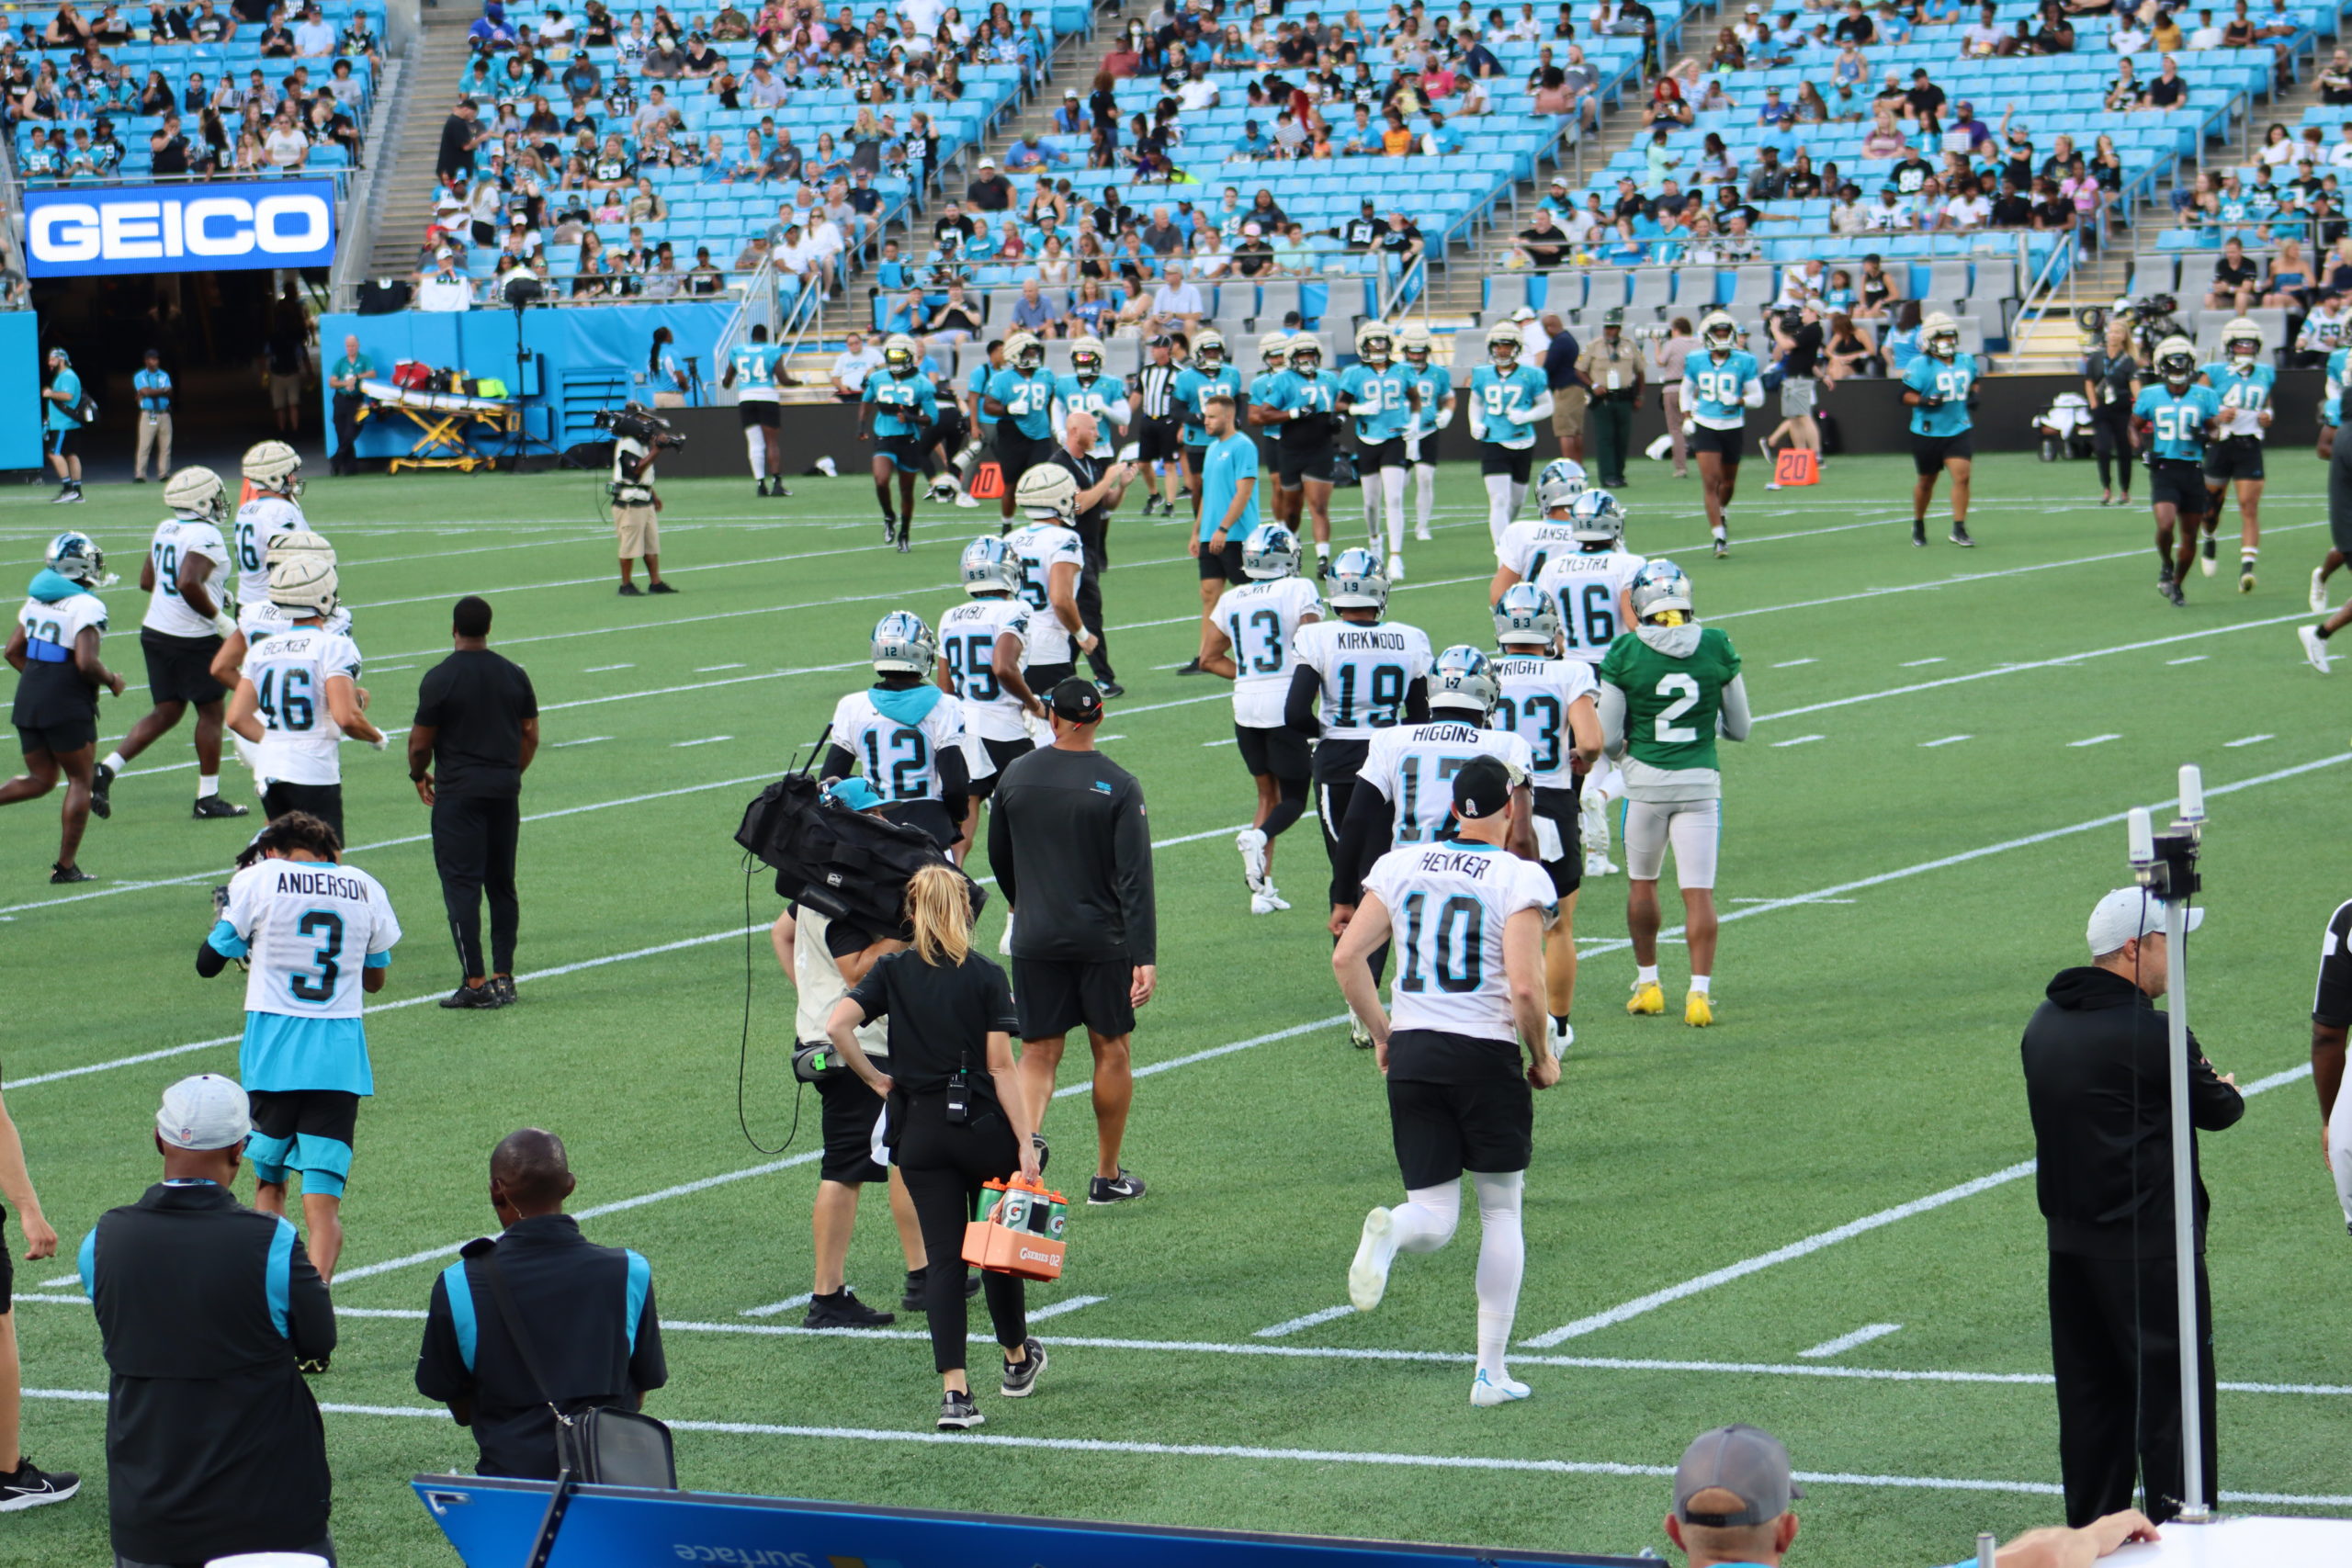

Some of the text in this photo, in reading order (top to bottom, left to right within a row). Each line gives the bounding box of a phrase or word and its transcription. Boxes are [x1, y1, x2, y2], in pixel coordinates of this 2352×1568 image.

[613, 96, 630, 117] 51
[30, 154, 49, 171] 59
[907, 140, 926, 158] 22
[1899, 169, 1924, 193] 88
[29, 194, 330, 263] GEICO
[1351, 224, 1373, 243] 51
[737, 356, 767, 383] 54
[876, 385, 915, 404] 53
[1011, 383, 1047, 411] 78
[1300, 385, 1331, 412] 71
[1363, 380, 1400, 410] 92
[1698, 373, 1736, 402] 90
[1936, 371, 1969, 401] 93
[2222, 384, 2264, 411] 40
[1484, 386, 1523, 416] 97
[2154, 406, 2199, 441] 50
[1779, 455, 1808, 480] 20
[1532, 527, 1573, 542] JANSE
[969, 570, 985, 580] 85
[1557, 557, 1608, 574] ZYLSTRA
[1344, 582, 1359, 592] 19
[1513, 617, 1531, 629] 83
[1558, 584, 1614, 649] 16
[885, 647, 897, 657] 12
[1229, 610, 1283, 676] 13
[1338, 631, 1406, 651] KIRKWOOD
[944, 634, 1000, 701] 85
[1493, 660, 1545, 677] WRIGHT
[258, 668, 315, 732] 46
[1333, 662, 1406, 728] 19
[1655, 672, 1700, 743] 2
[1413, 725, 1480, 744] HIGGINS
[862, 728, 928, 800] 12
[1396, 754, 1467, 844] 17
[277, 873, 369, 904] ANDERSON
[1399, 890, 1486, 994] 10
[288, 908, 345, 1005] 3
[1006, 1202, 1023, 1221] G
[1050, 1215, 1066, 1234] G
[1049, 1254, 1060, 1267] 02
[676, 1543, 812, 1568] Surface
